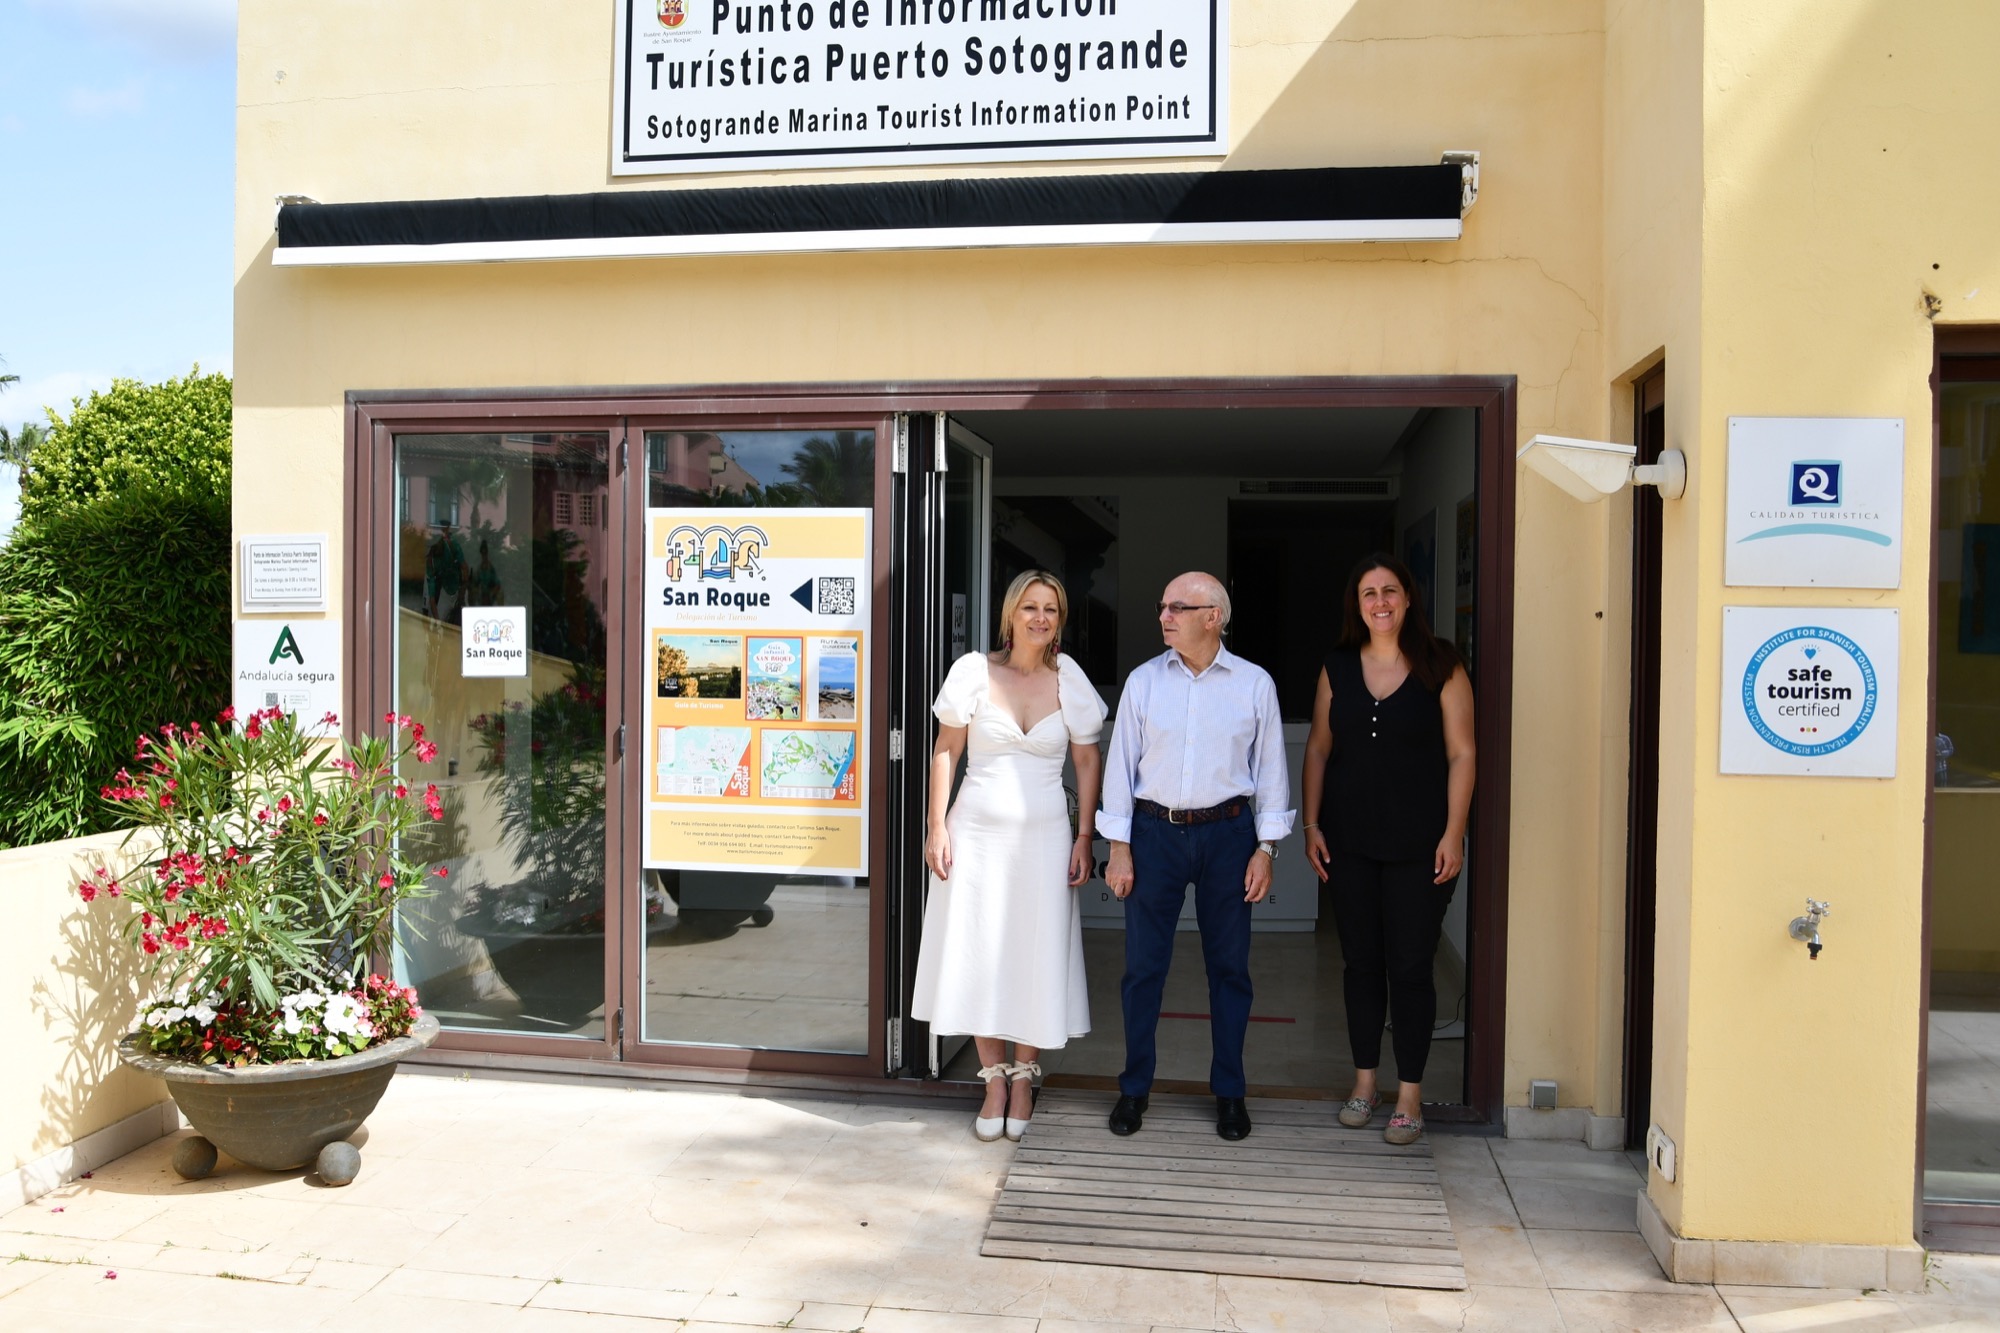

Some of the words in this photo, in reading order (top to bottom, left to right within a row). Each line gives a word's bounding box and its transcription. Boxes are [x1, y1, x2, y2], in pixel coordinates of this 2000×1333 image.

[712, 0, 814, 35] Punto
[829, 0, 869, 29] de
[662, 29, 702, 37] Ayuntamiento
[646, 46, 810, 91] Turística
[826, 41, 949, 82] Puerto
[964, 29, 1188, 83] Sotogrande
[647, 110, 780, 144] Sotogrande
[788, 106, 868, 133] Marina
[876, 103, 962, 131] Tourist
[971, 97, 1116, 126] Information
[1126, 95, 1191, 121] Point
[1749, 511, 1805, 519] CALIDAD
[663, 587, 699, 606] San
[707, 587, 770, 612] Roque
[676, 612, 716, 622] Delegación
[728, 613, 758, 621] Turismo
[1797, 628, 1816, 637] FOR
[1818, 629, 1856, 653] SPANISH
[466, 647, 486, 658] San
[489, 647, 523, 661] Roque
[1754, 631, 1795, 663] INSTITUTE
[297, 673, 335, 684] segura
[1787, 665, 1832, 682] safe
[1853, 650, 1875, 691] TOURISM
[1744, 673, 1754, 707] SYSTEM
[1767, 682, 1852, 700] tourism
[1778, 703, 1840, 717] certified
[1853, 693, 1875, 732] QUALITY
[1747, 707, 1789, 751] PREVENTION
[1791, 744, 1811, 755] RISK
[1813, 736, 1848, 754] HEALTH
[731, 766, 742, 790] San
[740, 765, 750, 797] Roque
[840, 773, 849, 795] Soto
